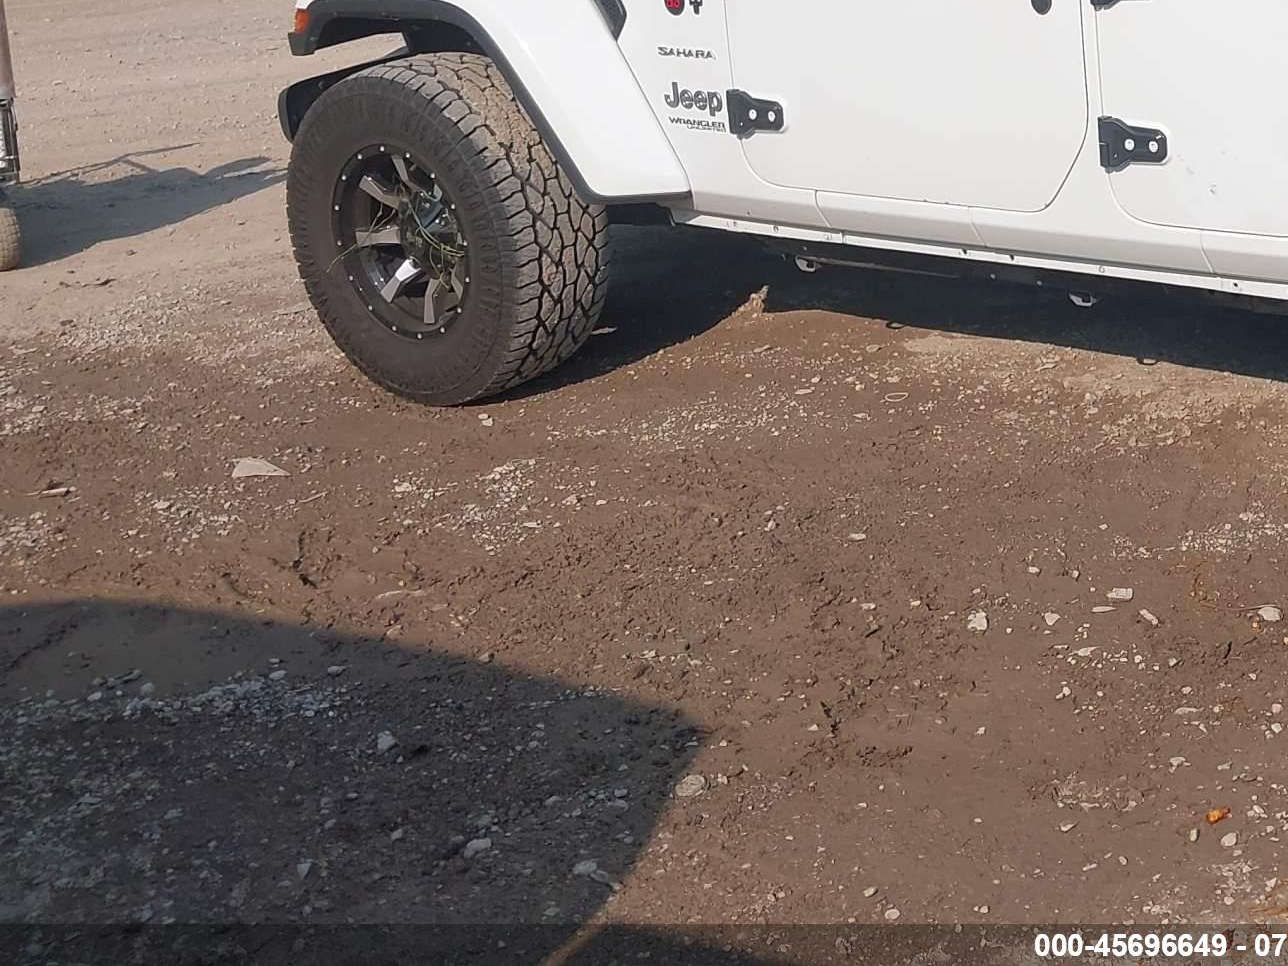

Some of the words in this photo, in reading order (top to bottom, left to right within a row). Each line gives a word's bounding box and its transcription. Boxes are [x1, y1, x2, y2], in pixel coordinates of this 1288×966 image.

[657, 46, 714, 59] SAHARA
[663, 81, 723, 117] Jeep
[668, 116, 726, 128] WRANGLER
